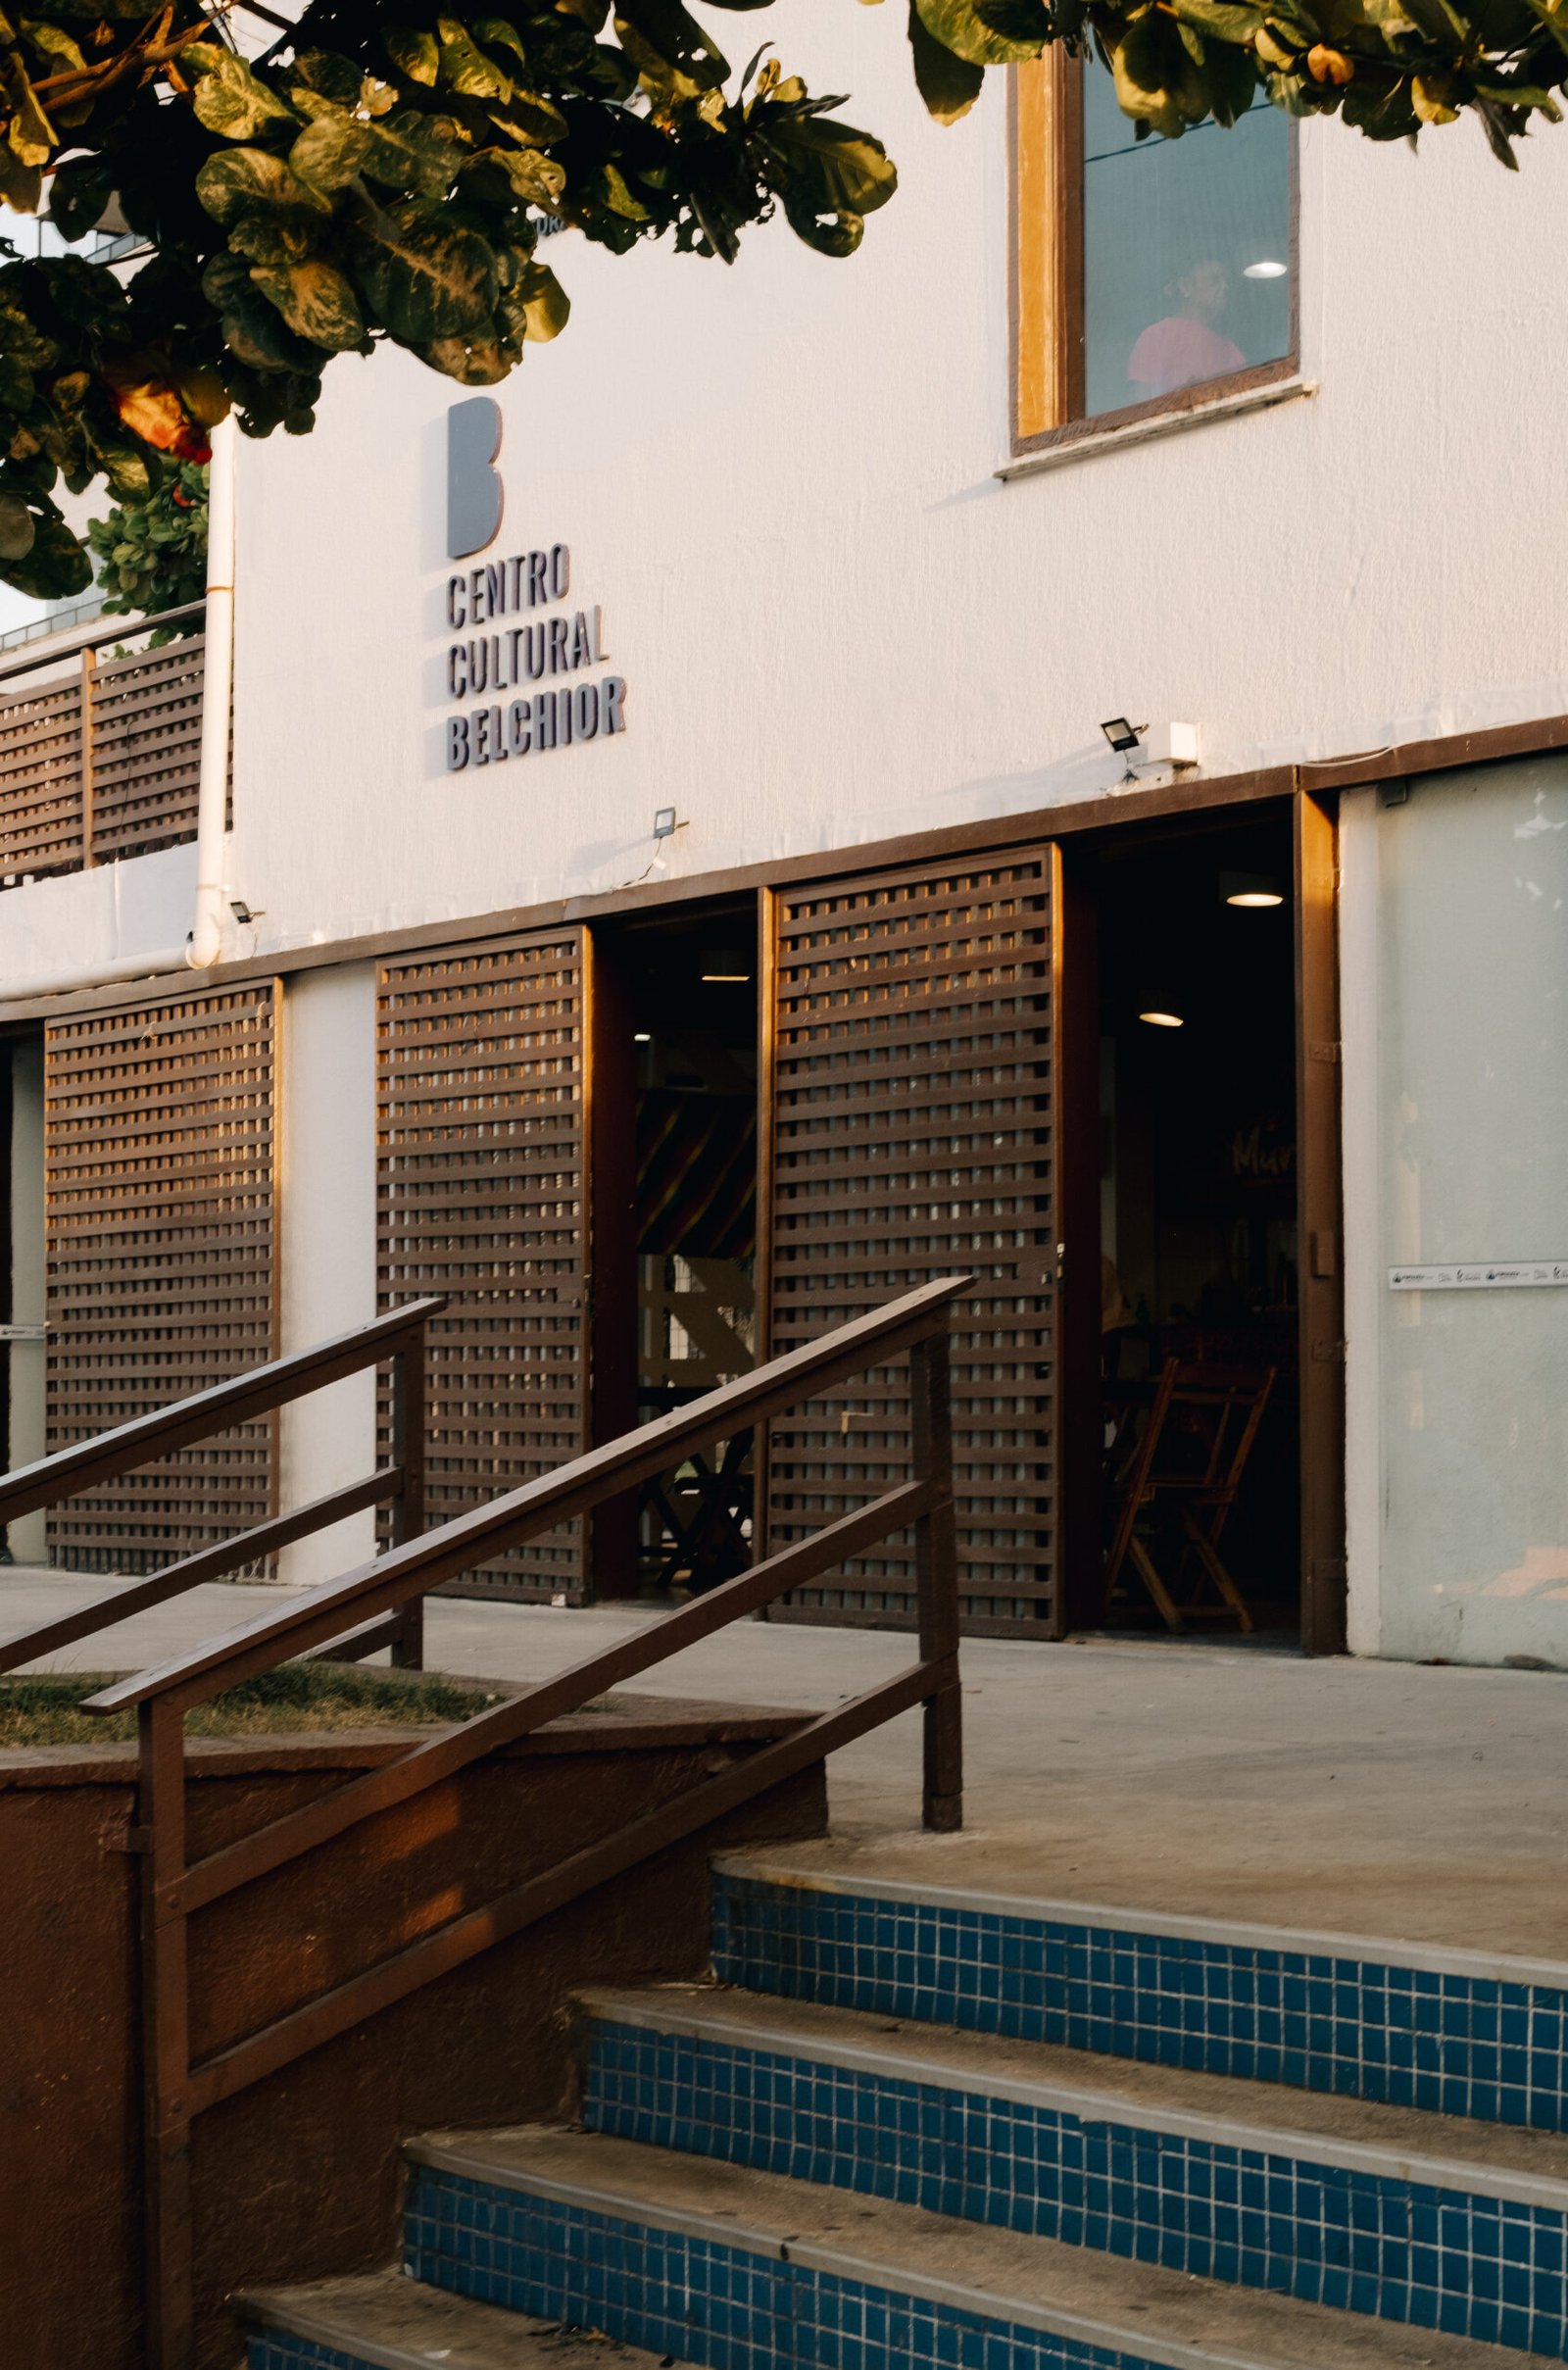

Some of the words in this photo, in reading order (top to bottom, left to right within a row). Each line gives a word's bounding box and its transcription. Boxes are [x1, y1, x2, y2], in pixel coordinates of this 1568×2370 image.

[447, 396, 504, 558] B
[447, 543, 569, 629] CENTRO
[448, 604, 610, 699] CULTURAL
[447, 675, 627, 770] BELCHIOR
